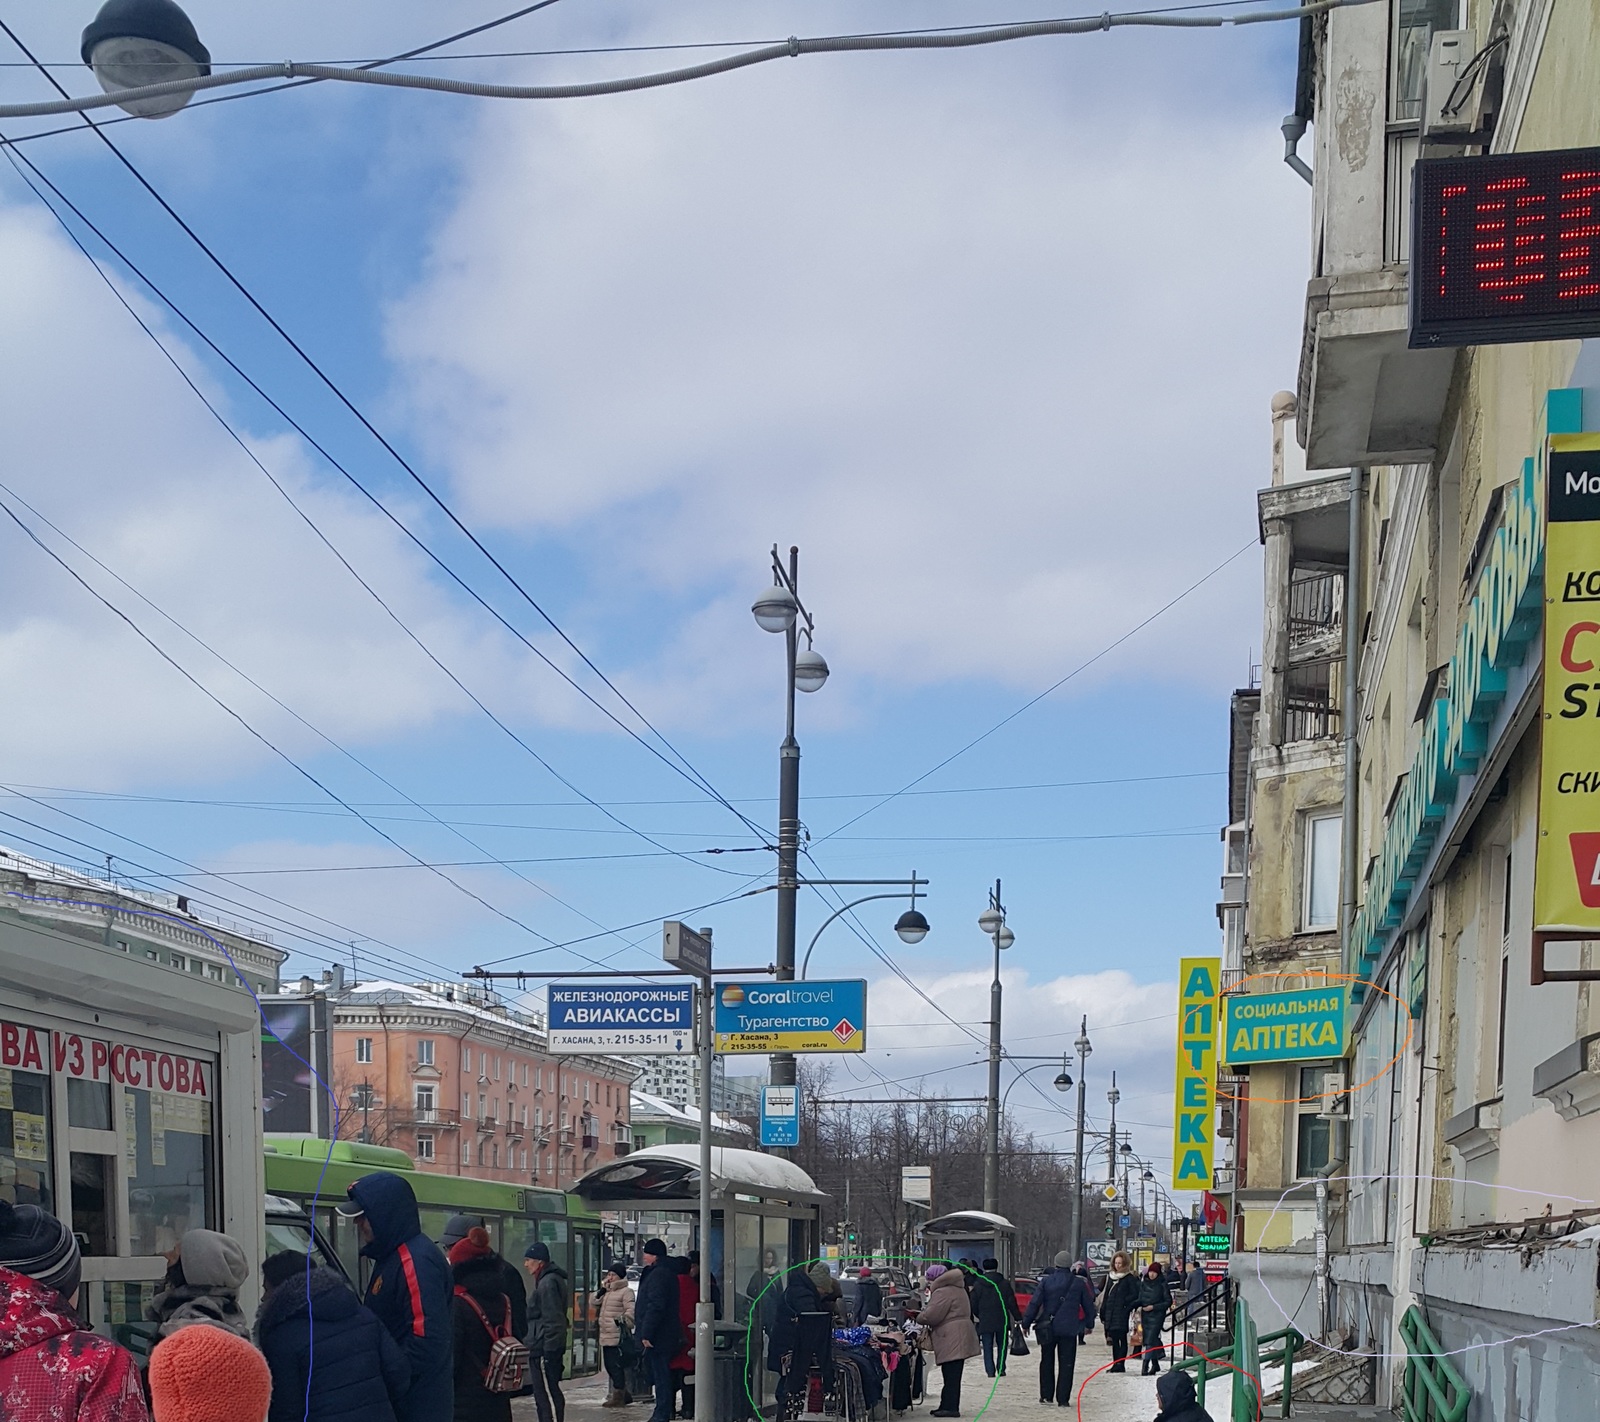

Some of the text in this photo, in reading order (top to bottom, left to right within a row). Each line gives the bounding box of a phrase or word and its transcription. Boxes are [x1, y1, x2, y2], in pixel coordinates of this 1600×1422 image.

[553, 990, 689, 1003] ЖЕЛЕЗНОДОРОЖНЫЕ
[563, 1007, 680, 1023] АВИАКАССЫ
[1234, 997, 1339, 1019] СОЦИАЛЬНАЯ
[737, 1015, 830, 1031] Турагентство
[562, 1036, 596, 1045] ХАСАНА,
[615, 1034, 668, 1044] 215-35-11
[740, 1033, 772, 1042] Хасана,
[1232, 1020, 1338, 1052] АПТЕКА
[54, 1031, 84, 1076] ИЗ
[1177, 967, 1215, 1180] АПТЕКА
[1199, 1235, 1229, 1243] АПТЕКА
